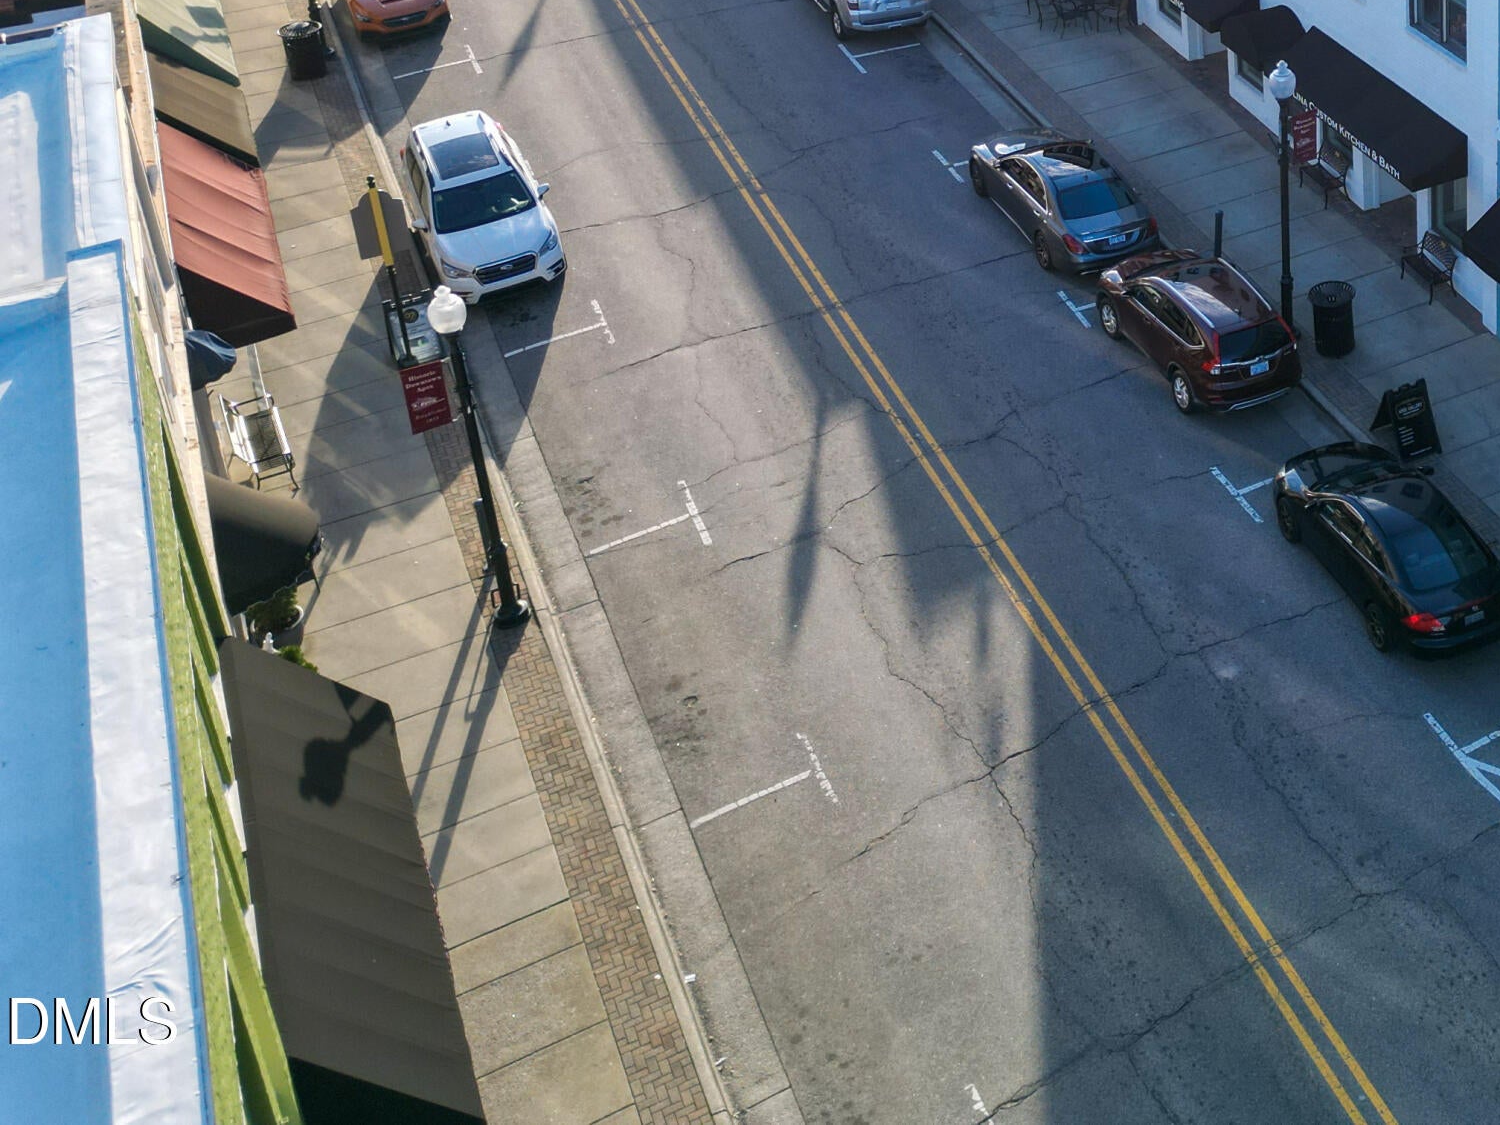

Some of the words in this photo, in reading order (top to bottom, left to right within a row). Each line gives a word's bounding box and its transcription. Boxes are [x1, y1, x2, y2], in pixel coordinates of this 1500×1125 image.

[1339, 124, 1371, 156] KITCHEN
[1371, 149, 1379, 162] &
[1379, 154, 1400, 180] BATH
